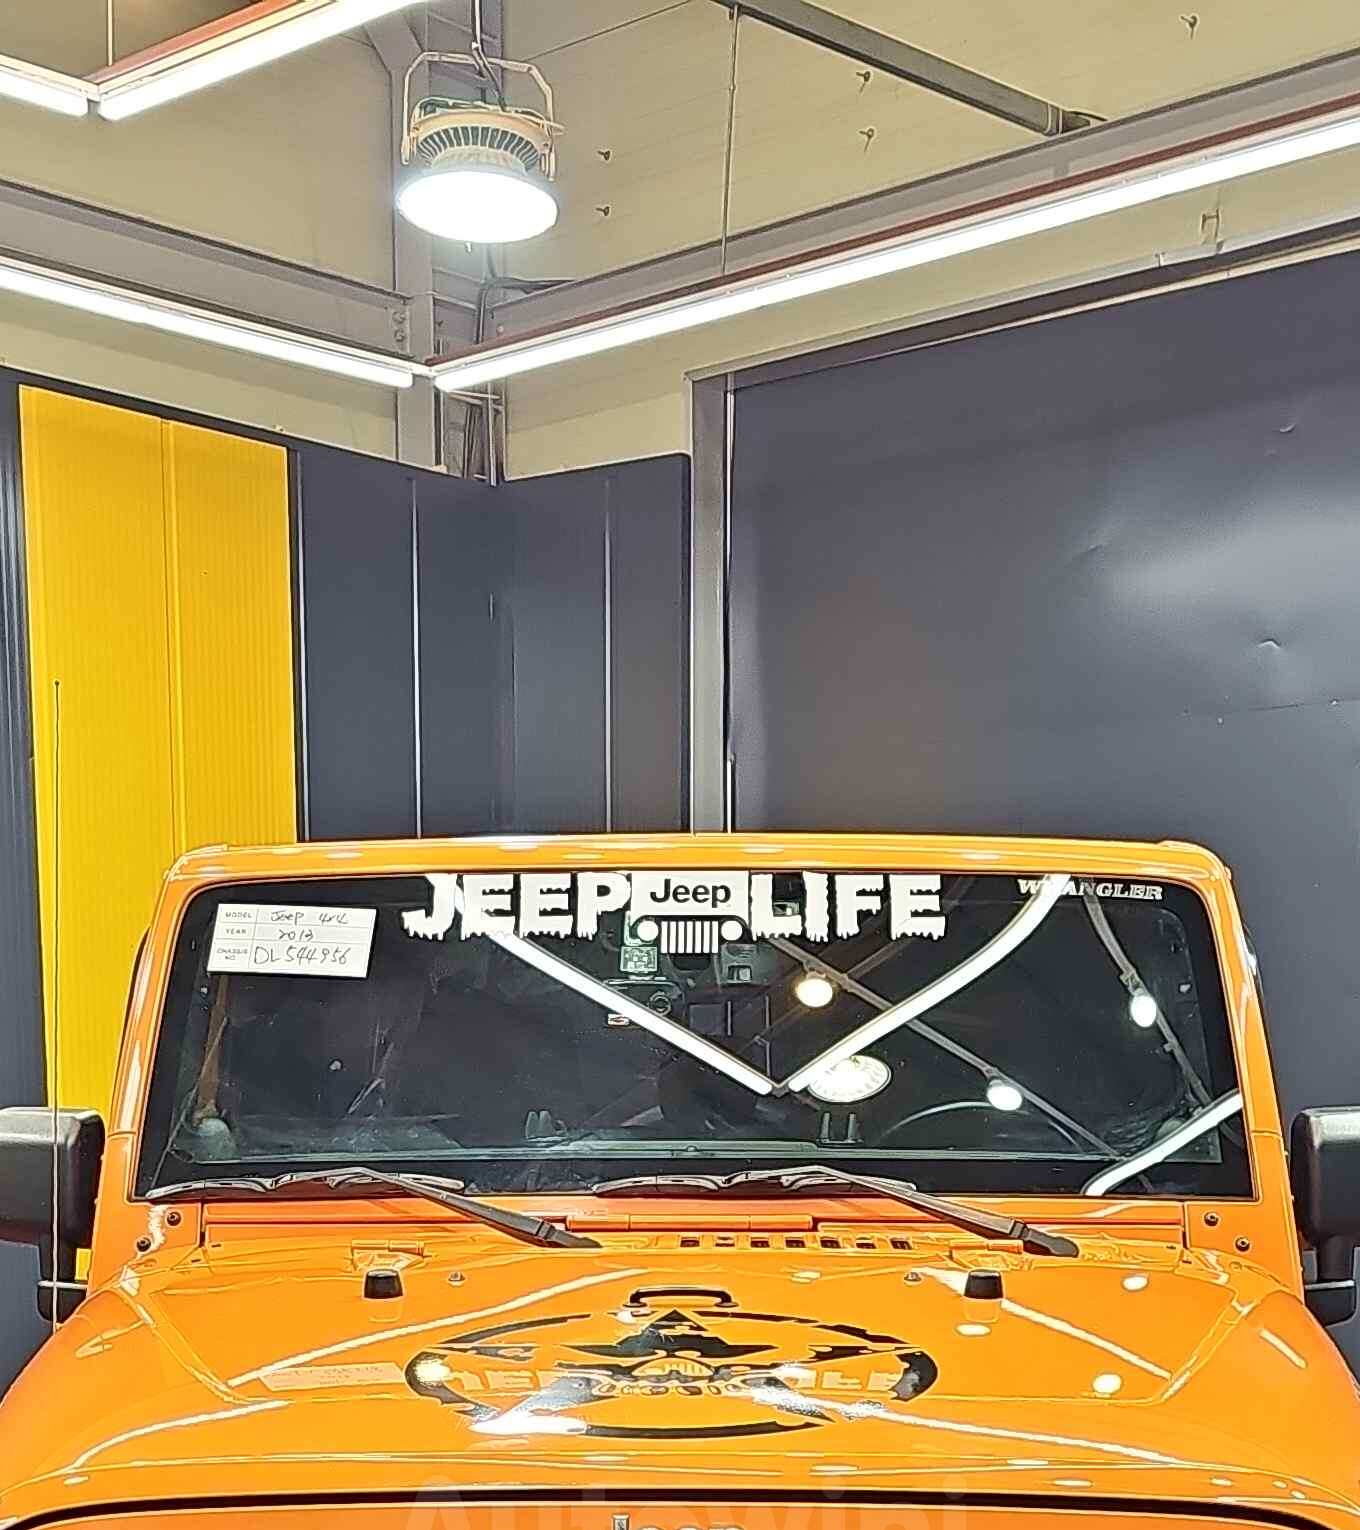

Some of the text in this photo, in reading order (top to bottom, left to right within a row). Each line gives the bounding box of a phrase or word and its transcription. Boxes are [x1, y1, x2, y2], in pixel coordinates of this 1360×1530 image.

[650, 879, 732, 908] Jeep
[1017, 878, 1163, 901] WANGLER
[401, 872, 946, 943] JEEP LIFE
